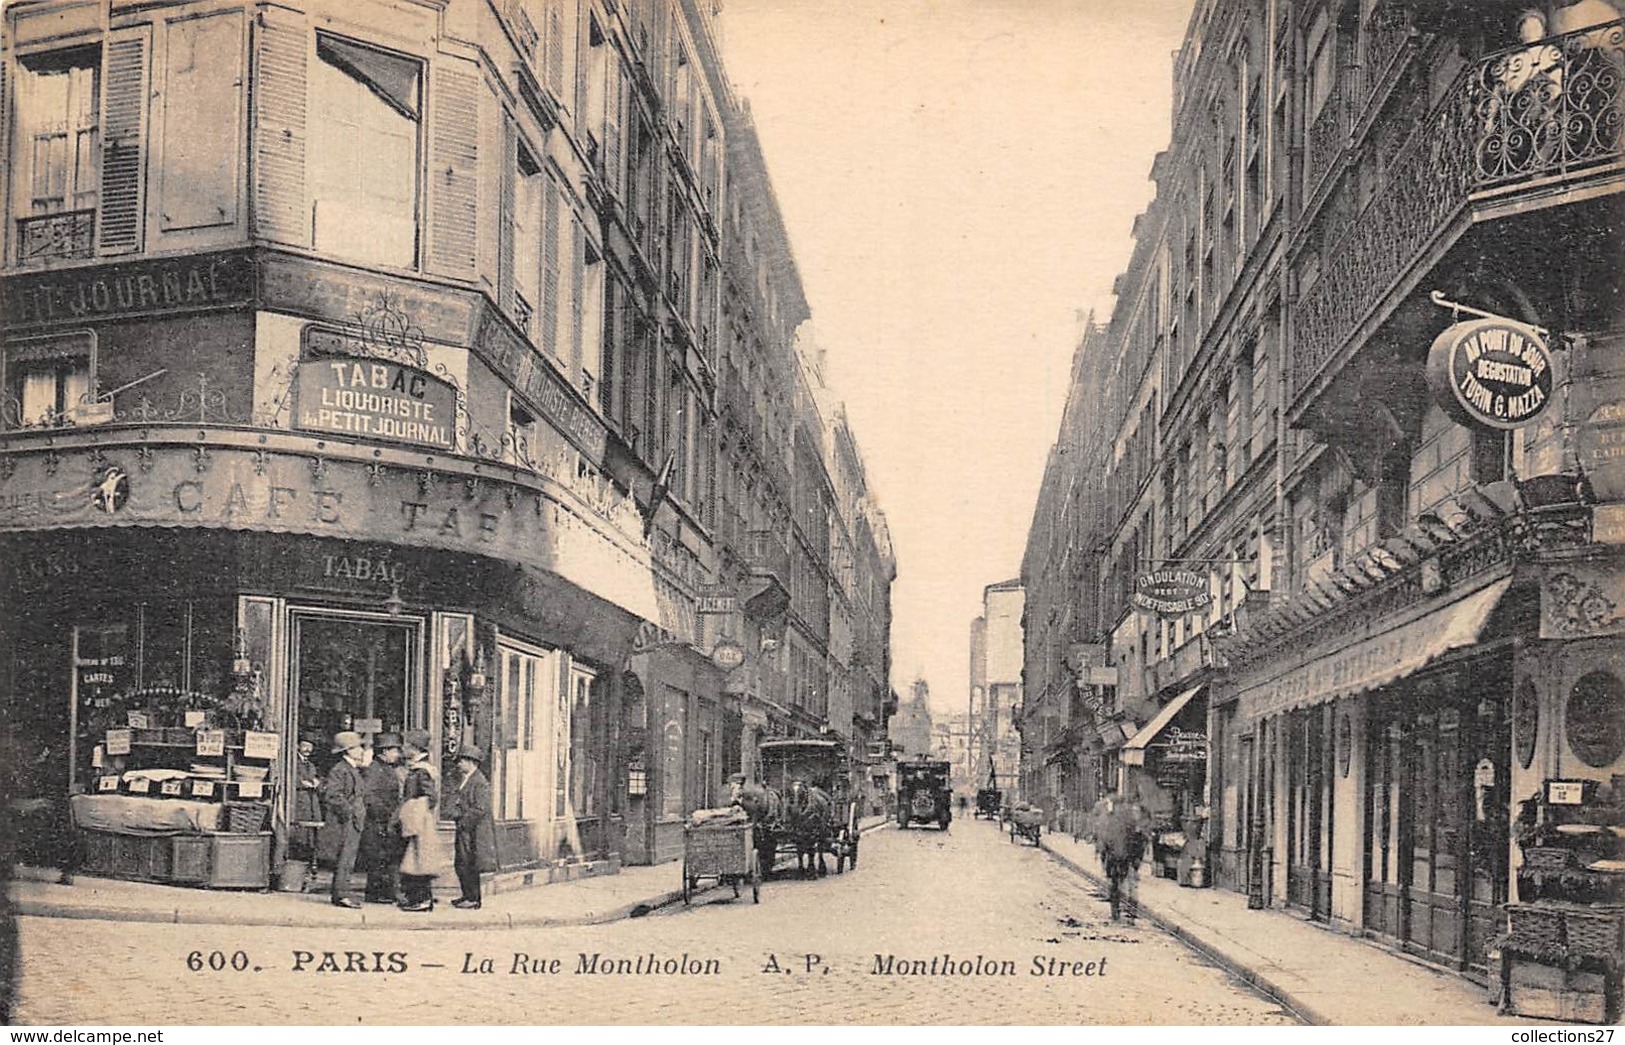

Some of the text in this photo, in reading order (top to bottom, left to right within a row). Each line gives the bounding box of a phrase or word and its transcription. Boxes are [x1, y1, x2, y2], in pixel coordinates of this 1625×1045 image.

[70, 262, 228, 316] JOURNAL
[1464, 328, 1546, 377] AU POINT DU JOUR
[330, 362, 427, 400] TABAC
[1477, 358, 1532, 387] DEGUSTATION
[321, 386, 435, 422] LIQUORISTE
[1460, 370, 1493, 413] TURIN
[1508, 384, 1545, 418] MAZZA
[318, 409, 372, 433] PETIT
[372, 416, 450, 446] JOURNAL
[172, 480, 343, 525] CAFE
[322, 554, 406, 584] TABAC
[1139, 570, 1206, 589] ONDULATION
[83, 672, 115, 684] CARTES
